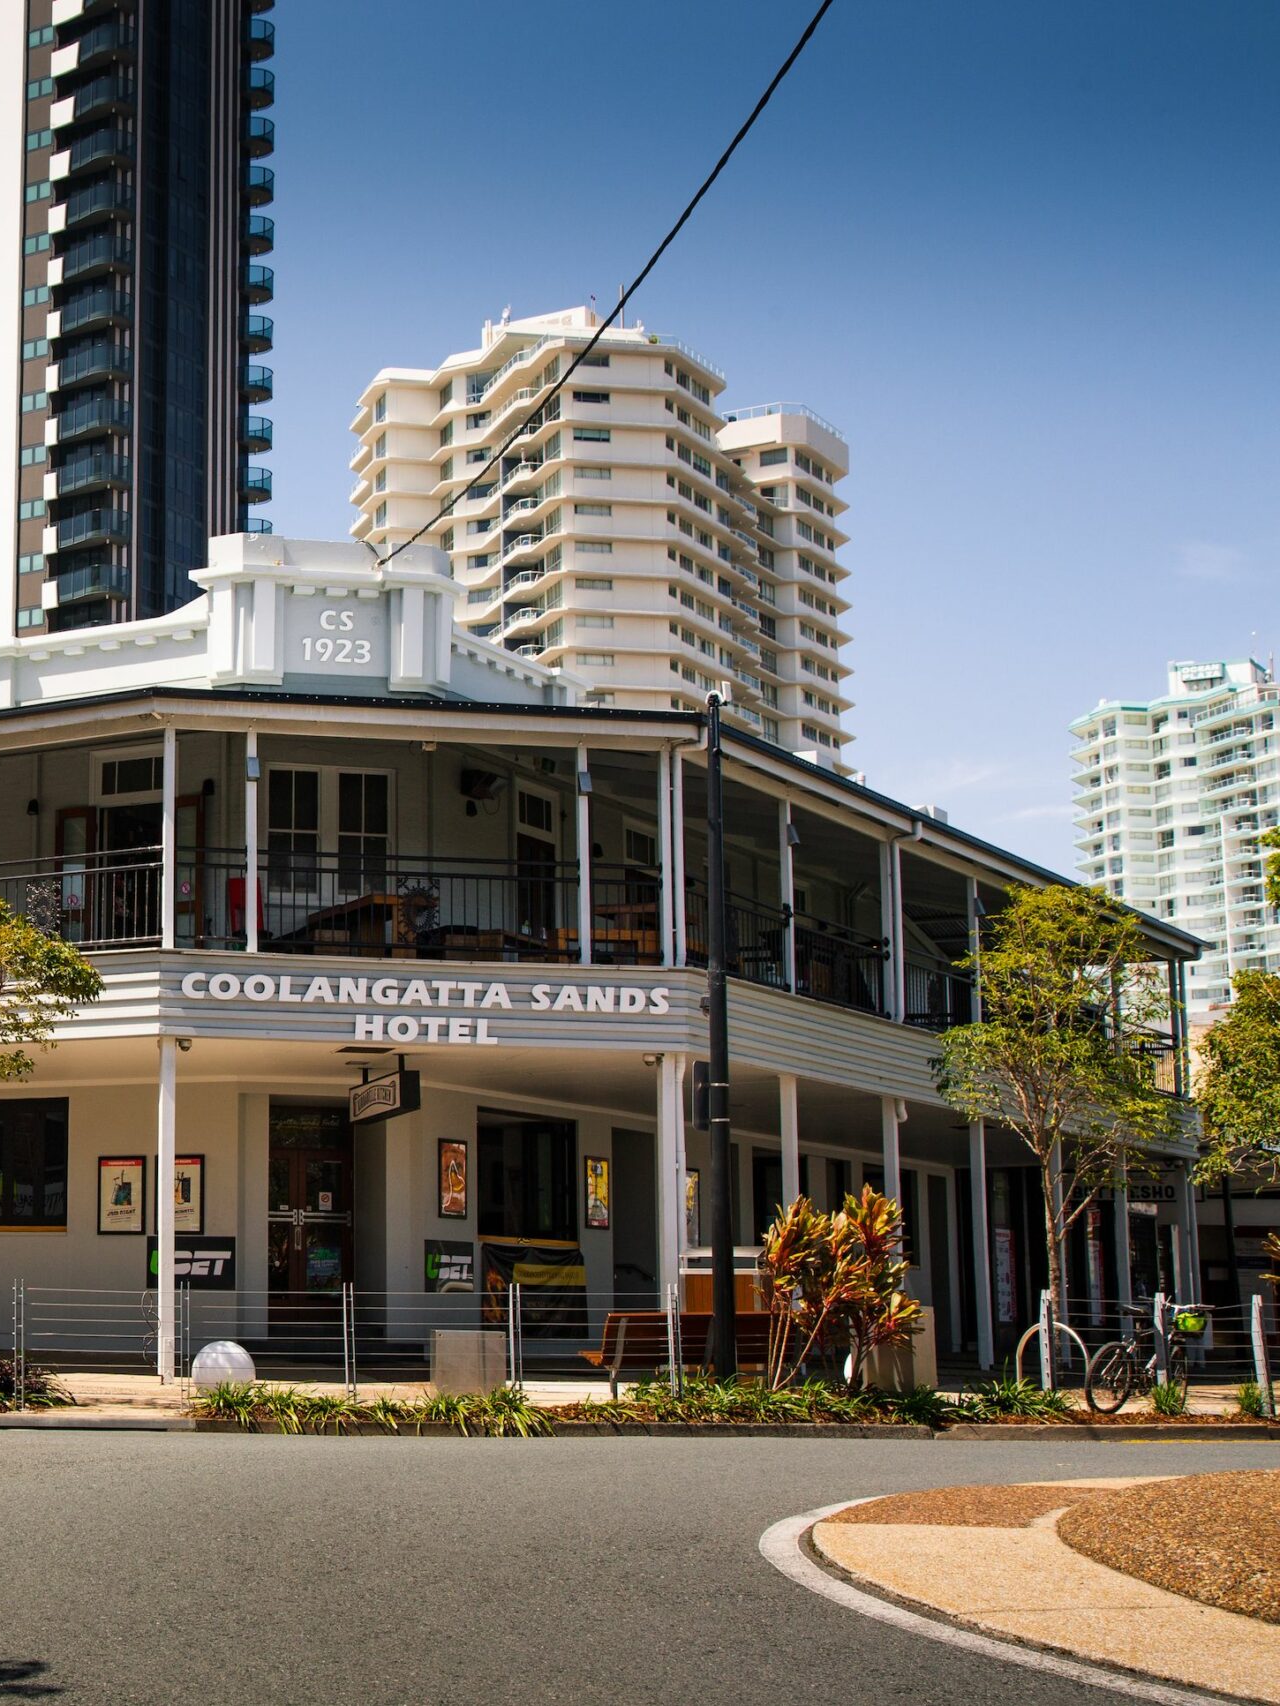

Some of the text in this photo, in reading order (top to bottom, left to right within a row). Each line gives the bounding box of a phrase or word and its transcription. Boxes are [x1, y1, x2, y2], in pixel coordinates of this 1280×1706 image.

[320, 610, 354, 631] CS
[302, 638, 372, 664] 1923
[181, 972, 670, 1015] COOLANGATTA SANDS
[354, 1014, 498, 1045] HOTEL
[426, 1253, 472, 1280] UBET
